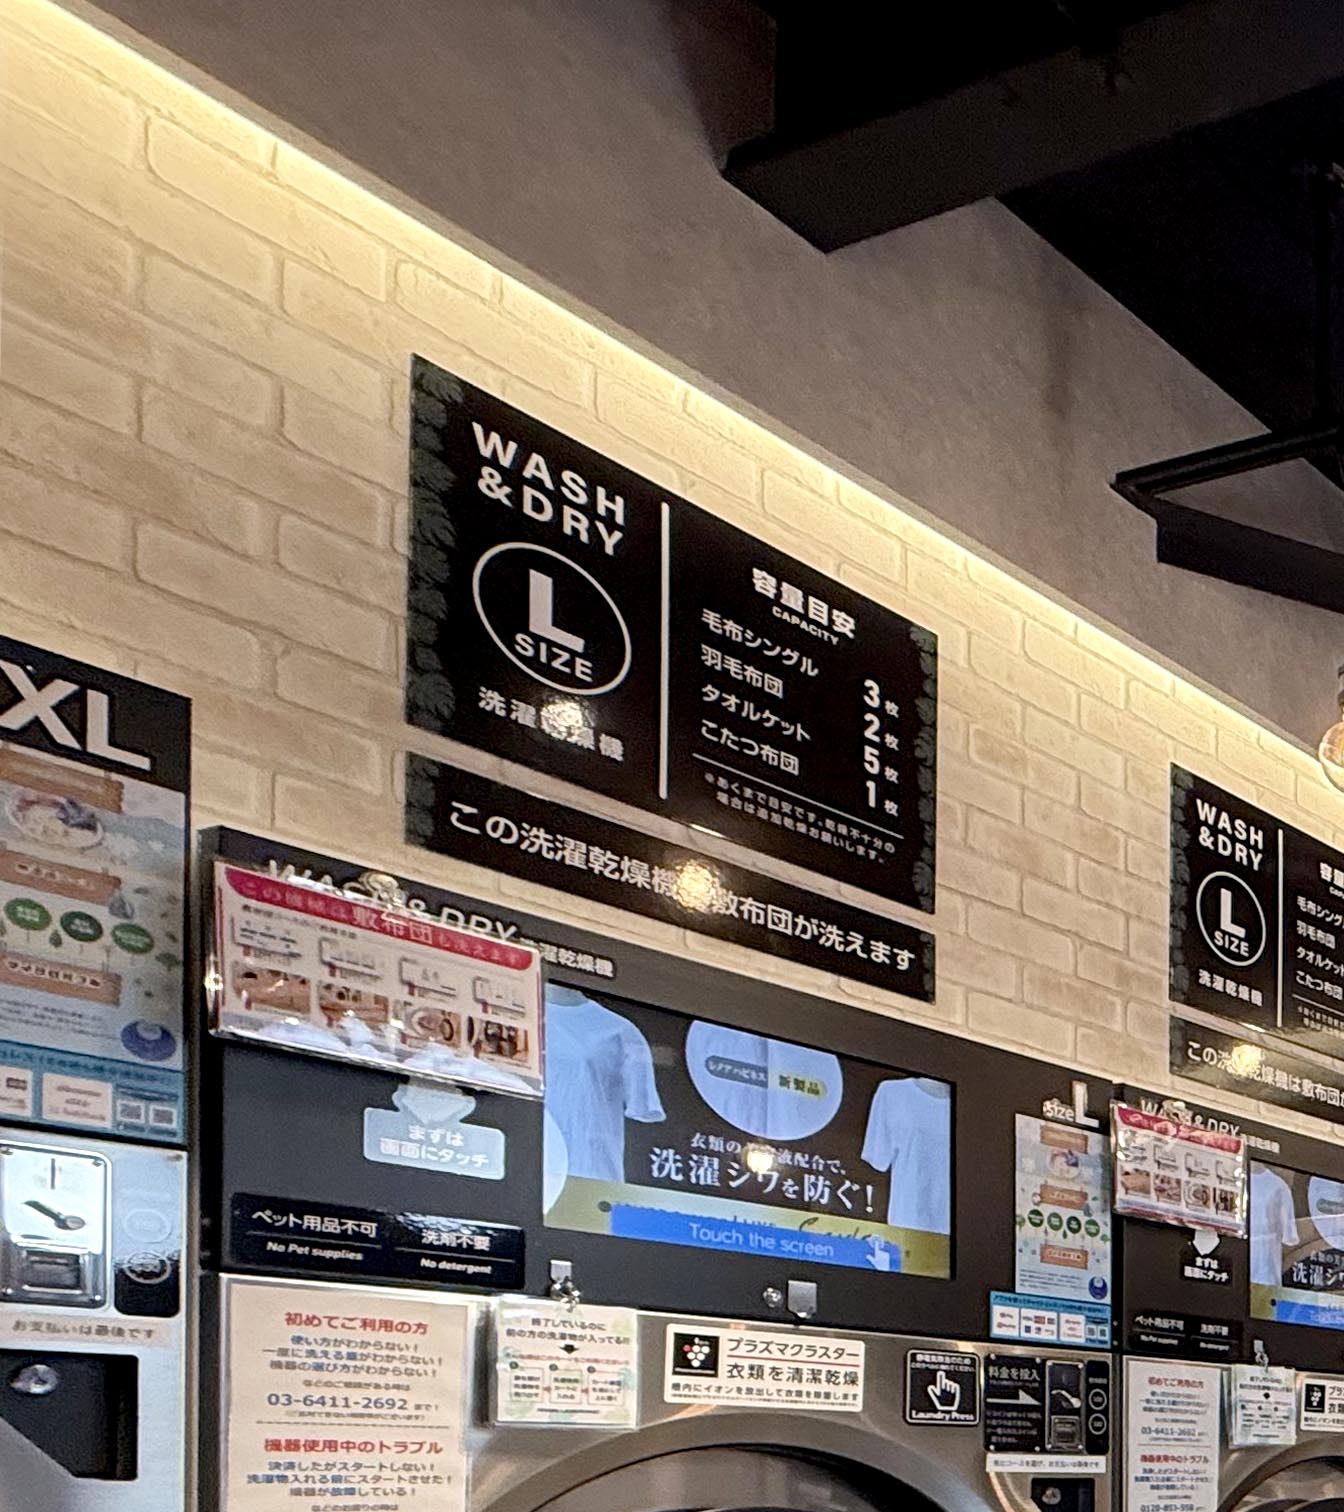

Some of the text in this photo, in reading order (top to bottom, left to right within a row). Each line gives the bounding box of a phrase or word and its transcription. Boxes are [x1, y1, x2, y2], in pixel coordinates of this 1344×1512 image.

[472, 422, 624, 525] WASH
[477, 465, 623, 556] &DRY
[530, 567, 585, 653] L
[752, 567, 857, 639] 容量目安
[700, 609, 820, 677] 毛布シングル
[771, 605, 840, 647] CAPACITY
[514, 633, 594, 683] SIZE
[700, 643, 784, 699] 羽毛布団
[700, 683, 812, 743] タオルケット
[700, 719, 801, 776] こたつ布団
[1196, 798, 1264, 849] WASH
[1199, 825, 1264, 873] &DRY
[1220, 888, 1247, 938] L
[1213, 929, 1251, 958] SIZE
[777, 1074, 823, 1097] 新製品
[379, 1136, 490, 1170] 画面にタッチ
[408, 1125, 465, 1148] まずは
[251, 1208, 379, 1240] ペット用品不可
[420, 1228, 491, 1253] 洗剤不要
[689, 1221, 835, 1258] Touch the screen
[266, 1239, 365, 1263] No Pet supplies
[419, 1255, 437, 1270] No
[284, 1311, 429, 1336] 初めてご利用の方
[726, 1336, 860, 1360] プラズマクラスター
[726, 1361, 860, 1387] 衣類を清潔乾燥
[266, 1391, 409, 1412] 03-6411-2692
[263, 1438, 443, 1456] 機器使用中のトラブル
